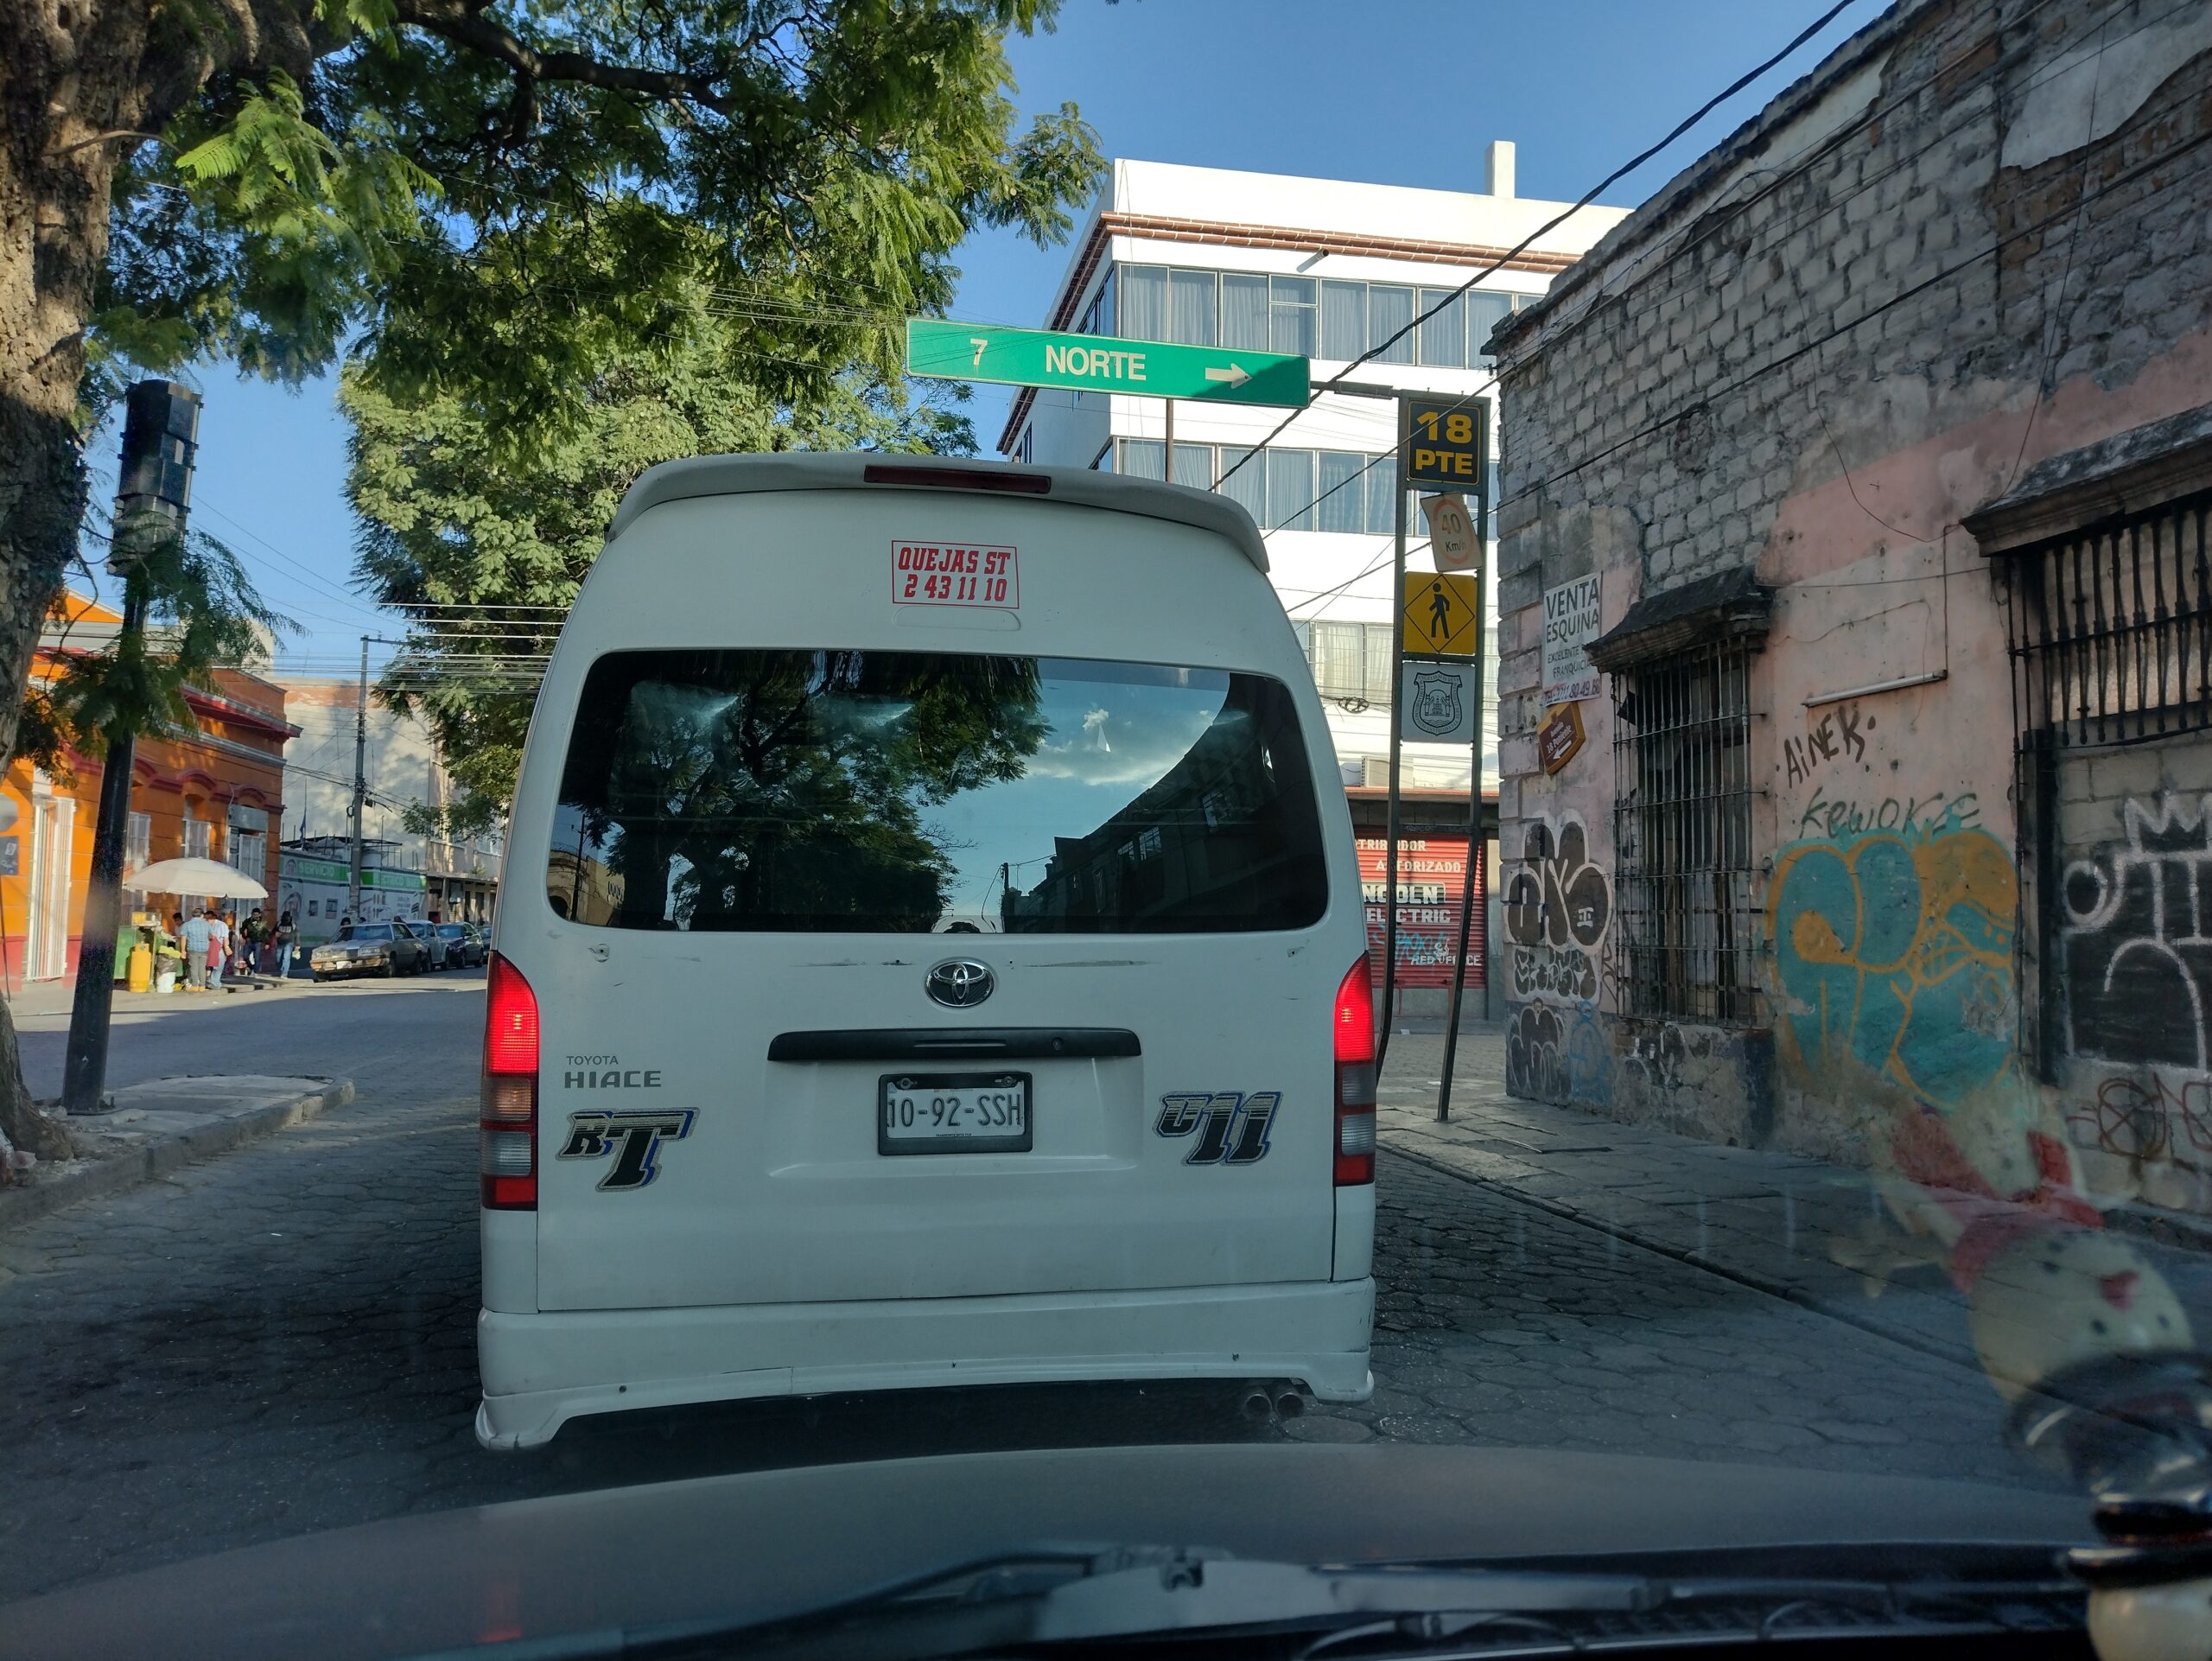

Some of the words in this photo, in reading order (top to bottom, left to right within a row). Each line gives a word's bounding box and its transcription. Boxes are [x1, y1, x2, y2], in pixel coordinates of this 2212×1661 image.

[969, 338, 988, 366] 7
[1046, 345, 1147, 380] NORTE
[1416, 411, 1472, 443] 18
[1415, 449, 1472, 474] PTE
[1441, 512, 1462, 534] 40
[898, 547, 979, 573] QUEJAS
[984, 551, 1011, 575] ST
[904, 574, 918, 597] 2
[924, 575, 951, 599] 43
[957, 576, 976, 600] 11
[984, 578, 1007, 601] 10
[1546, 578, 1599, 620] VENTA
[1546, 608, 1599, 643] ESQUINA
[1547, 742, 1554, 754] 18
[299, 862, 335, 877] SERVICIO
[1376, 860, 1461, 872] ATORIZADO
[1366, 907, 1451, 924] ELCTRIC
[566, 1055, 619, 1066] TOYOTA
[564, 1070, 662, 1089] HIACE
